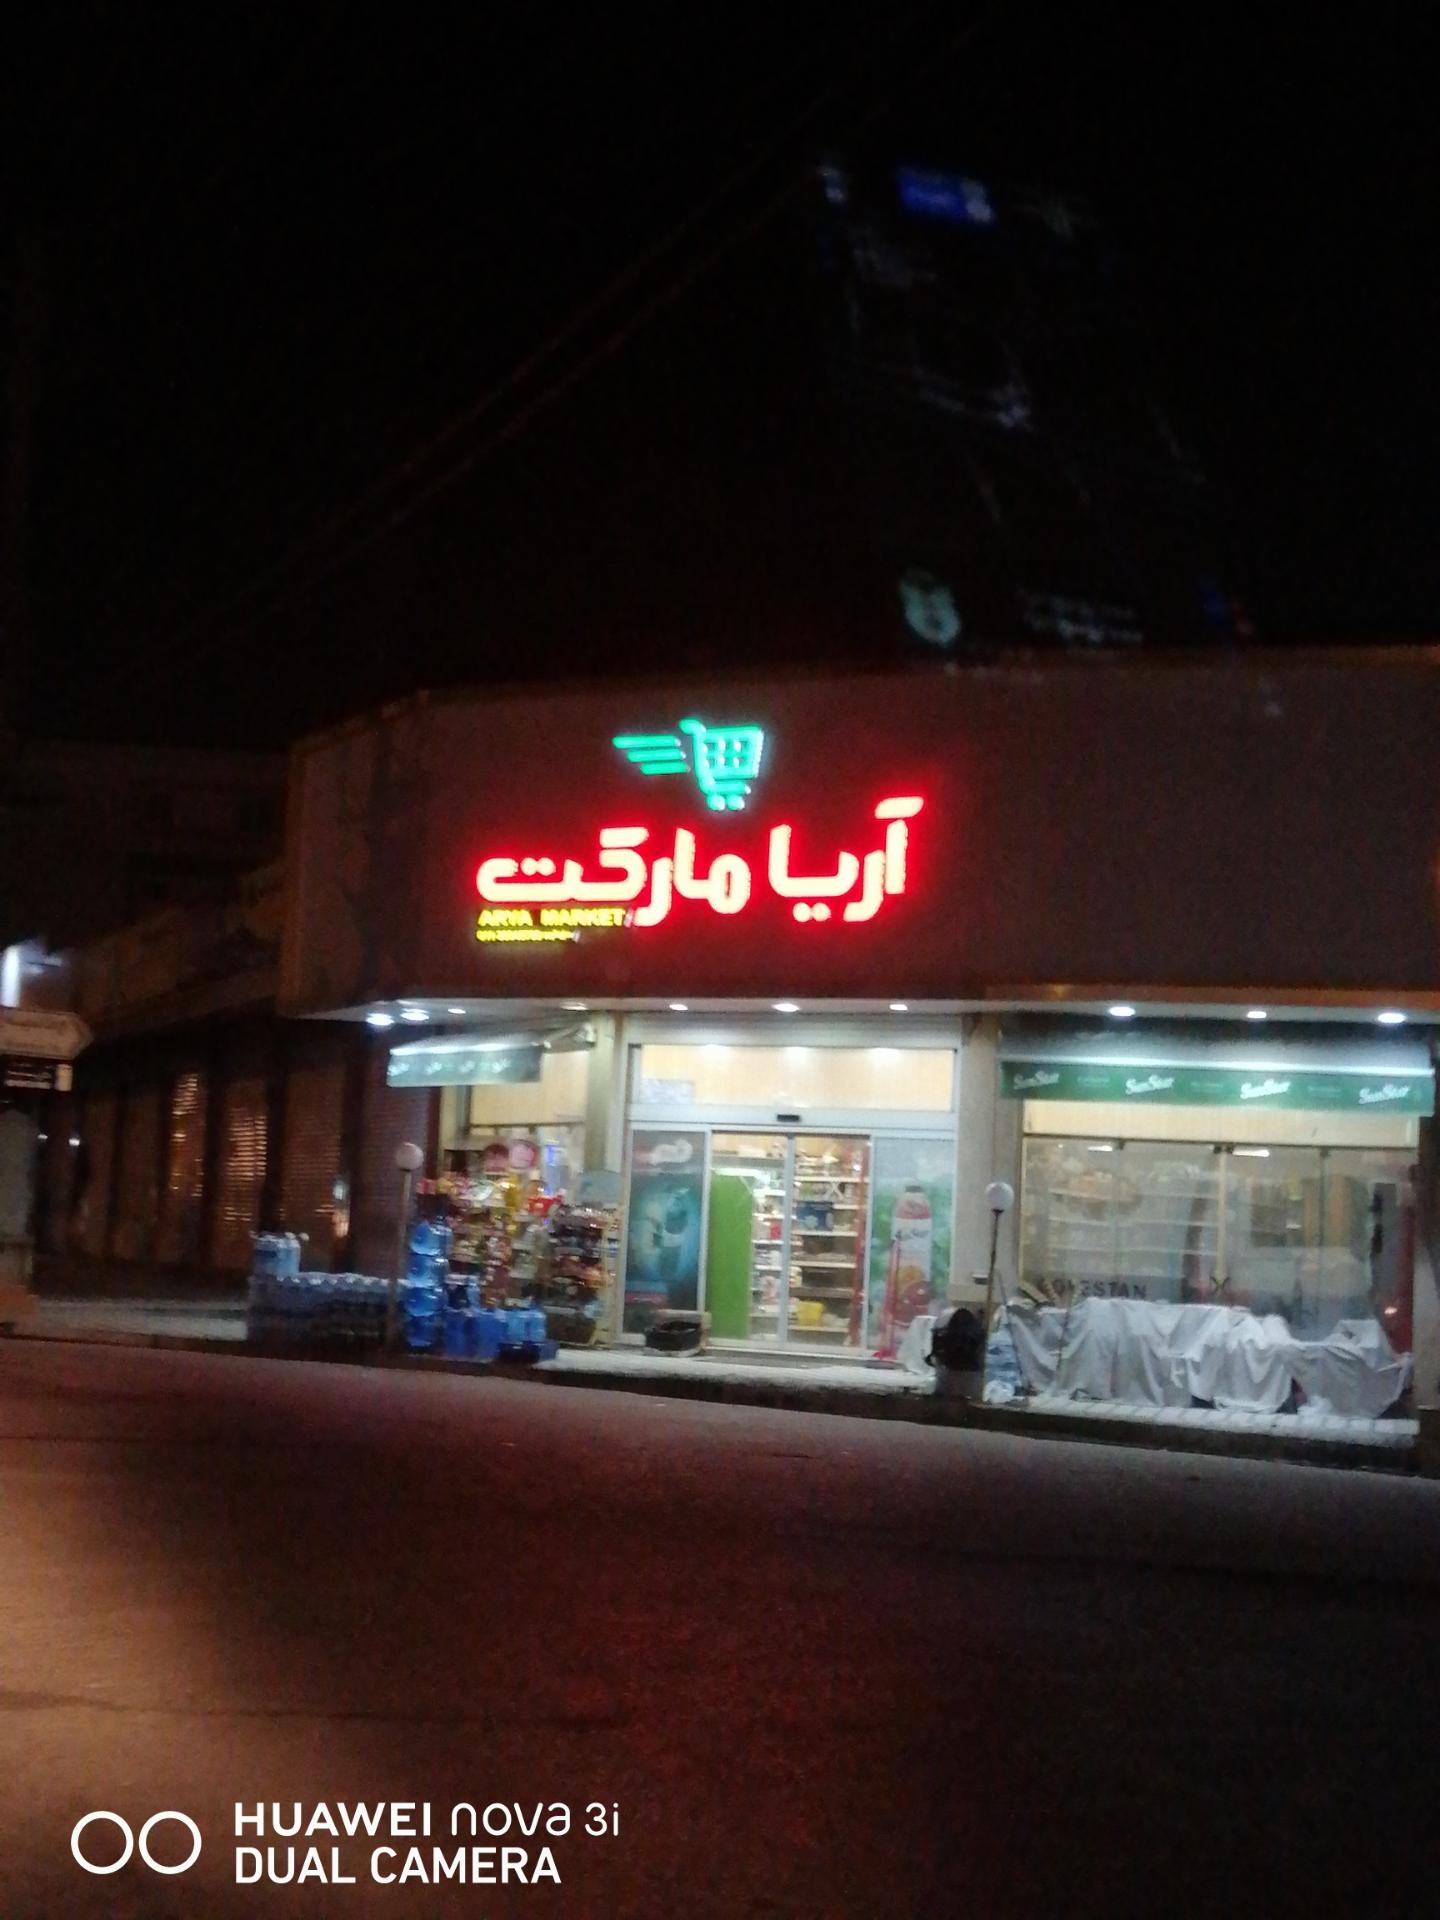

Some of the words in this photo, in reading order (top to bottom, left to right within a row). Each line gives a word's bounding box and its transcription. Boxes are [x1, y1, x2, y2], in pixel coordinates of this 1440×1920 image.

[476, 823, 752, 927] مارکت
[767, 795, 925, 923] آریا
[540, 907, 627, 927] MARKET
